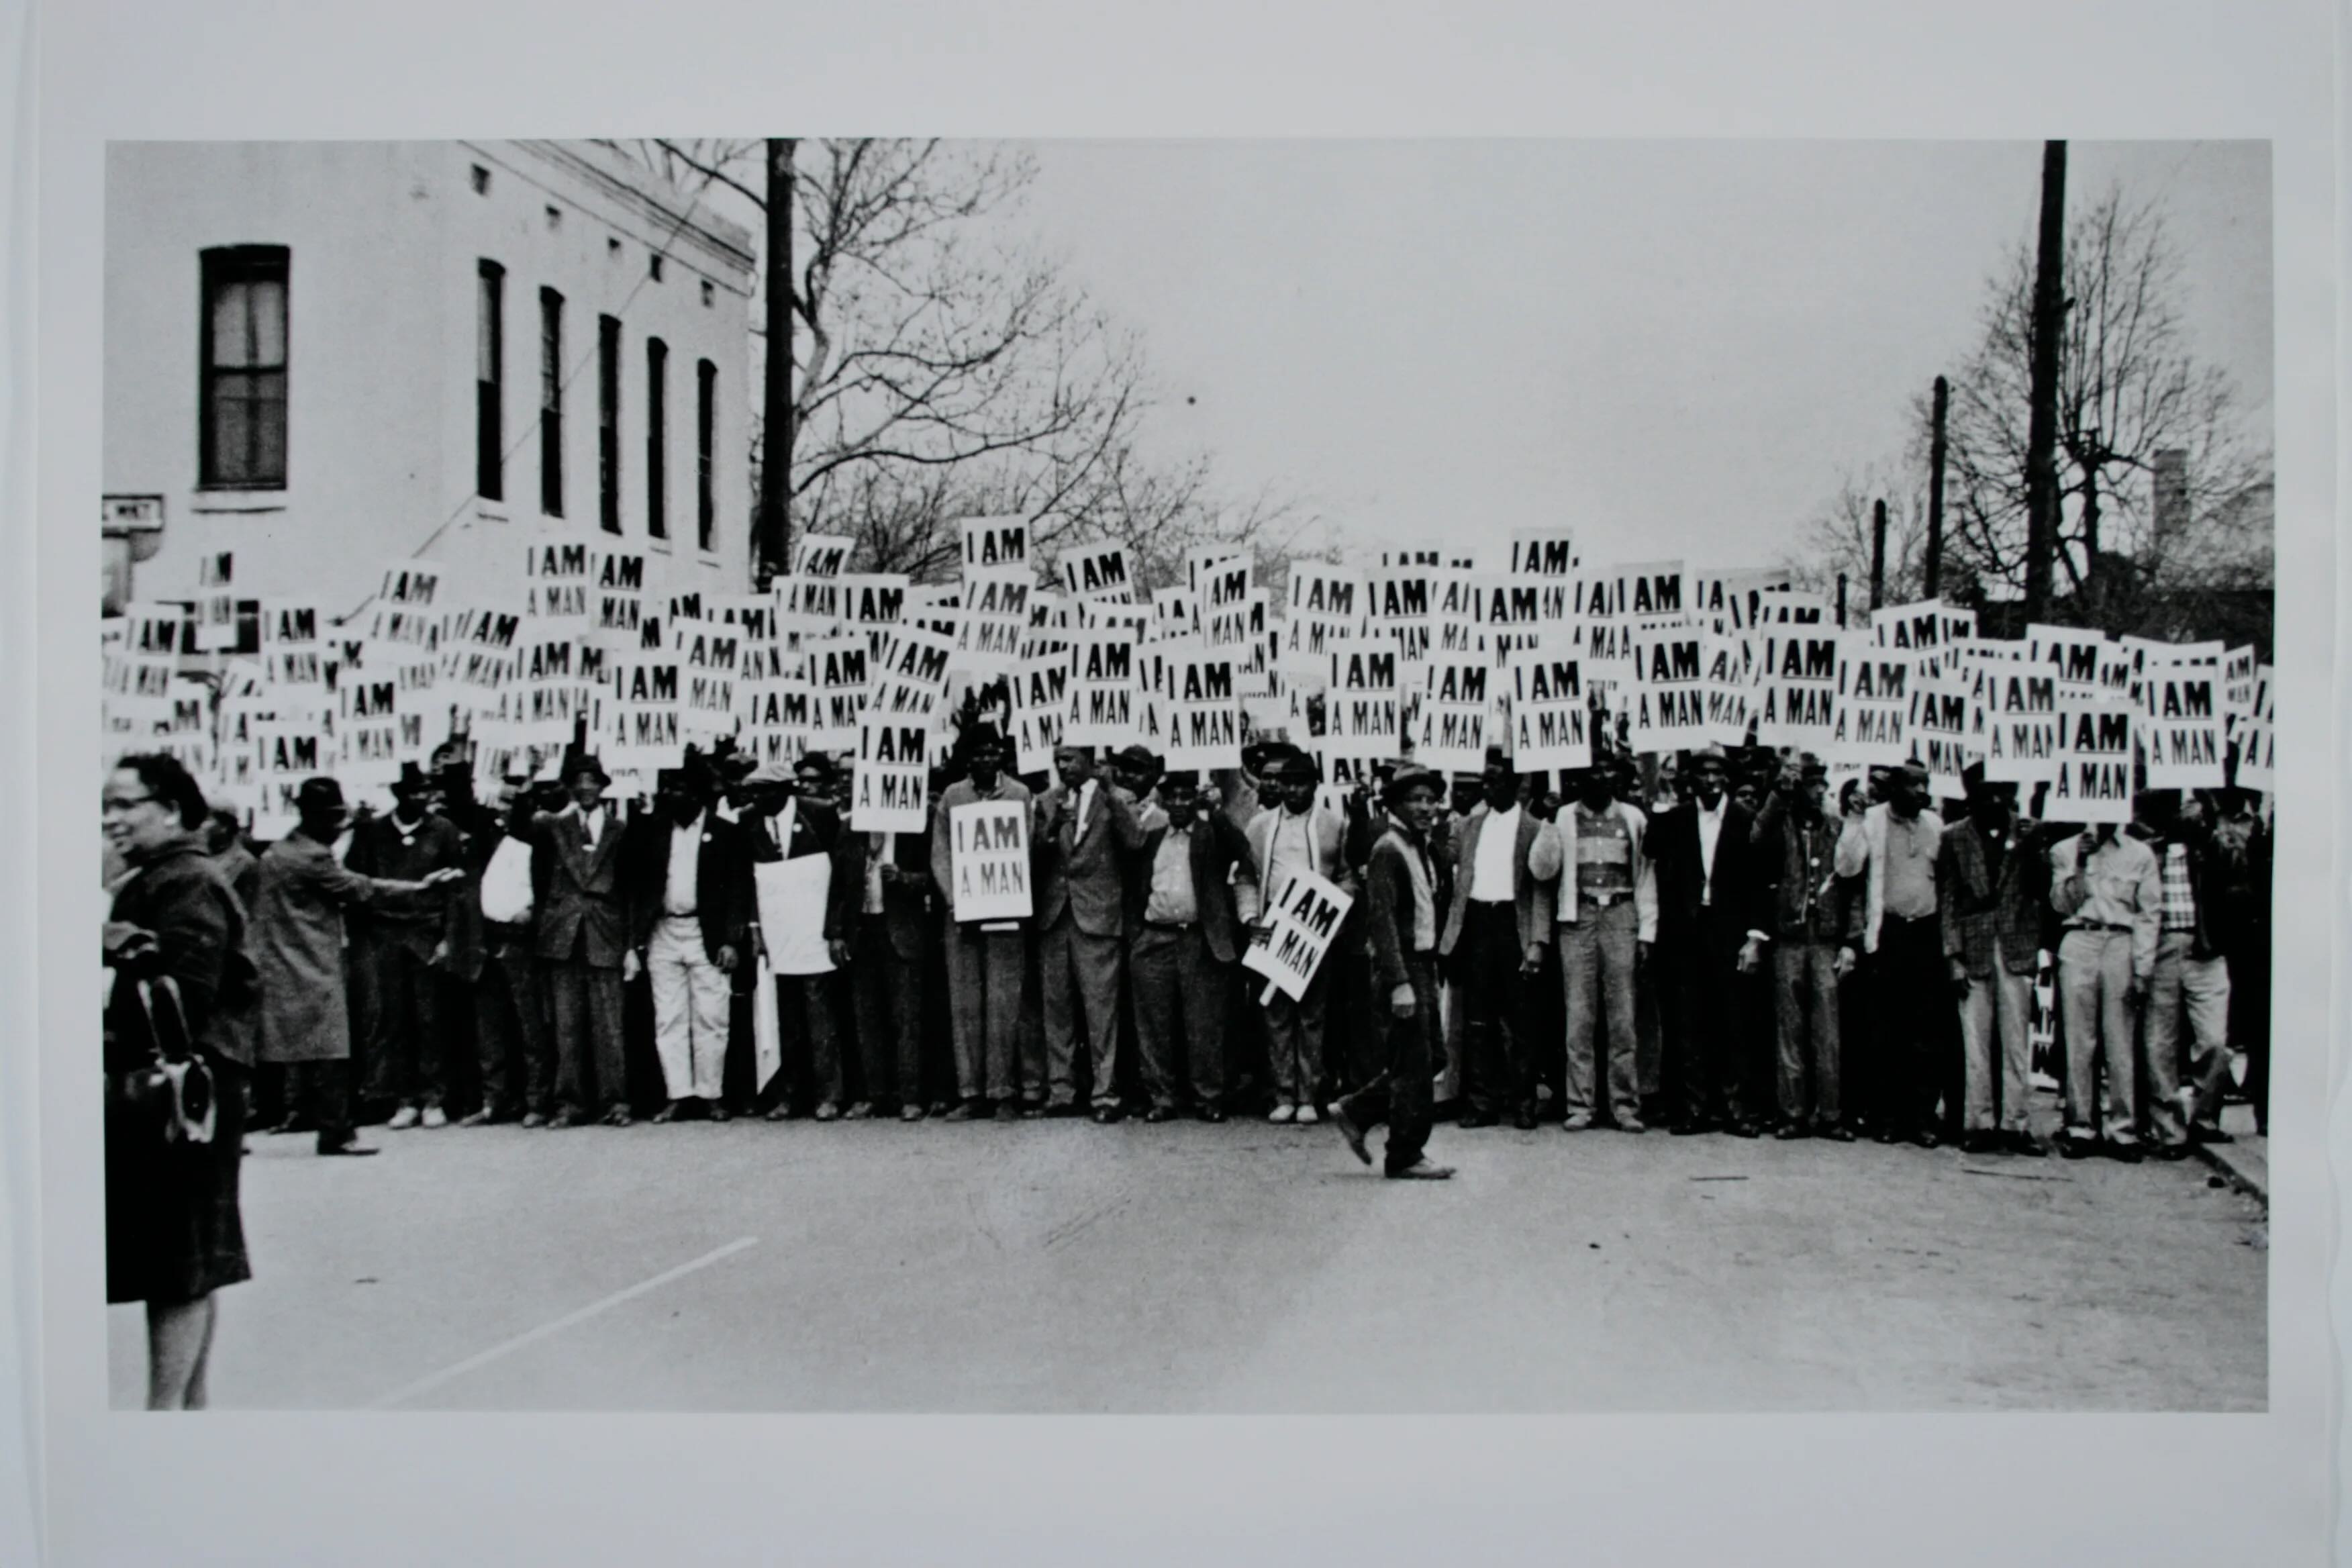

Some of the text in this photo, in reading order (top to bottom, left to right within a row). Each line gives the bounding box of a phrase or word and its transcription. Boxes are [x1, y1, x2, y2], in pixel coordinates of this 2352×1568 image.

[528, 544, 585, 576] I AM
[796, 546, 844, 576] I AM
[967, 528, 1024, 564] I AM
[1512, 540, 1569, 575] I AM
[379, 571, 438, 605] I AM
[599, 554, 644, 589] AM
[1067, 551, 1126, 593] I AM
[1210, 569, 1246, 605] AM
[546, 587, 586, 616] MAN
[788, 583, 836, 617] A MAN
[845, 587, 903, 620] I AM
[966, 581, 976, 610] I
[979, 581, 1029, 615] AM
[1293, 575, 1355, 616] I AM
[1369, 579, 1428, 617] I AM
[1475, 587, 1538, 624] I AM
[1575, 581, 1582, 615] I
[1618, 574, 1681, 614] I AM
[264, 608, 315, 642] I AM
[471, 610, 519, 647] AM
[599, 596, 640, 631] MAN
[1894, 612, 1937, 650] AM
[140, 619, 175, 651] AM
[689, 634, 738, 670] AM
[957, 620, 969, 652] A
[975, 622, 1020, 654] MAN
[516, 642, 571, 680] I AM
[810, 649, 867, 686] I AM
[885, 638, 899, 670] I
[897, 642, 950, 683] AM
[1072, 644, 1079, 679] I
[1085, 643, 1131, 679] AM
[1332, 652, 1395, 689] I AM
[1635, 641, 1700, 681] I AM
[1766, 638, 1835, 678] I AM
[2047, 642, 2097, 681] AM
[616, 665, 678, 701] I AM
[689, 677, 734, 714] MAN
[1014, 676, 1022, 709] I
[1167, 662, 1232, 700] I AM
[1439, 666, 1487, 702] AM
[1514, 660, 1580, 702] I AM
[1839, 659, 1907, 699] I AM
[1989, 676, 1996, 712] I
[2005, 675, 2054, 712] AM
[340, 681, 395, 718] I AM
[531, 688, 569, 721] MAN
[751, 692, 807, 725] I AM
[813, 697, 823, 730] A
[872, 682, 887, 712] A
[891, 685, 935, 714] MAN
[1069, 689, 1130, 725] A MAN
[1639, 689, 1704, 730] A MAN
[1763, 687, 1833, 726] A MAN
[1909, 690, 1918, 726] I
[1922, 692, 1964, 732] AM
[2148, 680, 2213, 717] I AM
[2253, 679, 2266, 718] I
[616, 712, 678, 747] A MAN
[1022, 720, 1033, 752] A
[1171, 709, 1234, 748] A MAN
[1332, 700, 1395, 736] A MAN
[1422, 712, 1483, 750] A MAN
[1519, 708, 1583, 750] A MAN
[1834, 709, 1903, 744] A MAN
[2058, 712, 2128, 751] I AM
[258, 736, 317, 770] I AM
[862, 726, 926, 764] I AM
[1928, 740, 1964, 777] MAN
[1990, 724, 2002, 760] A
[2151, 729, 2216, 765] A MAN
[859, 773, 924, 810] A MAN
[2057, 761, 2128, 800] A MAN
[957, 816, 1021, 853] I AM
[961, 861, 1024, 897] A MAN
[1278, 877, 1340, 939] I AM
[1276, 928, 1319, 980] MAN
